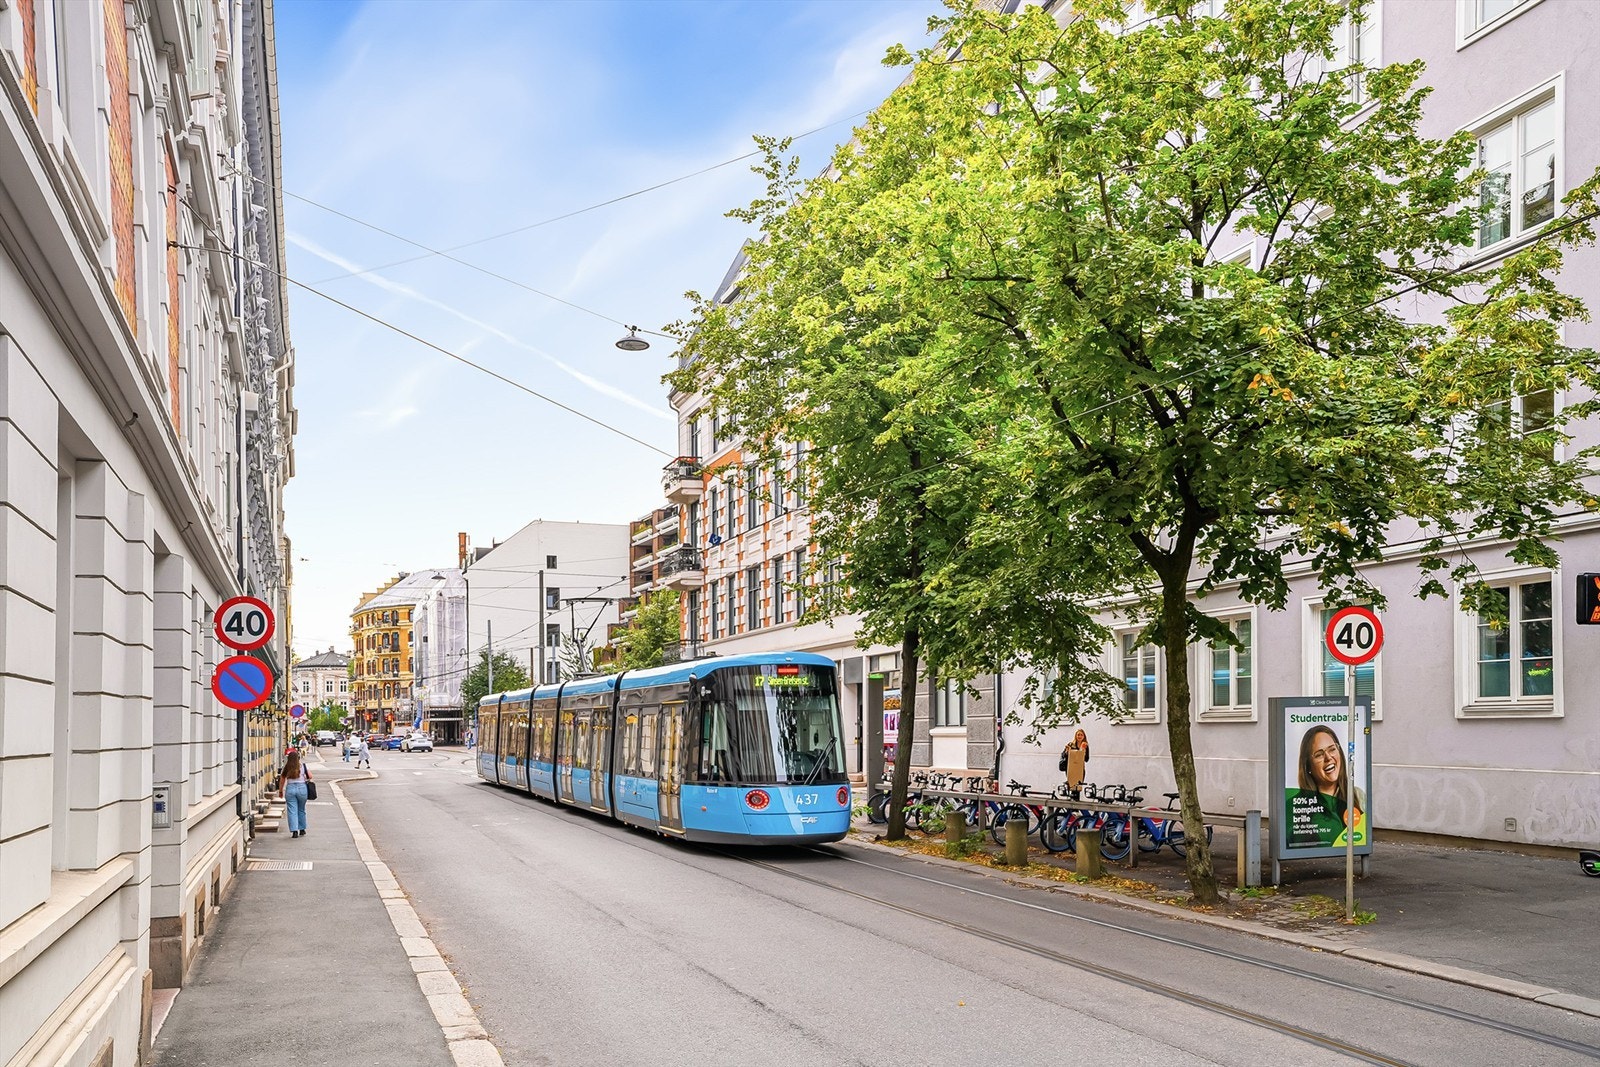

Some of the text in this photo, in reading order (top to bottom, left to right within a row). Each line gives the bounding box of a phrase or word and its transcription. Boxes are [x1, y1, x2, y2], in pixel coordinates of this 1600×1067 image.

[225, 610, 265, 637] 40
[1336, 622, 1373, 649] 40
[755, 676, 765, 687] 17
[1290, 713, 1359, 722] Studentraba!
[795, 793, 819, 805] 437
[1292, 796, 1318, 805] 50% på
[1292, 806, 1324, 814] komplett
[1293, 815, 1311, 823] brille
